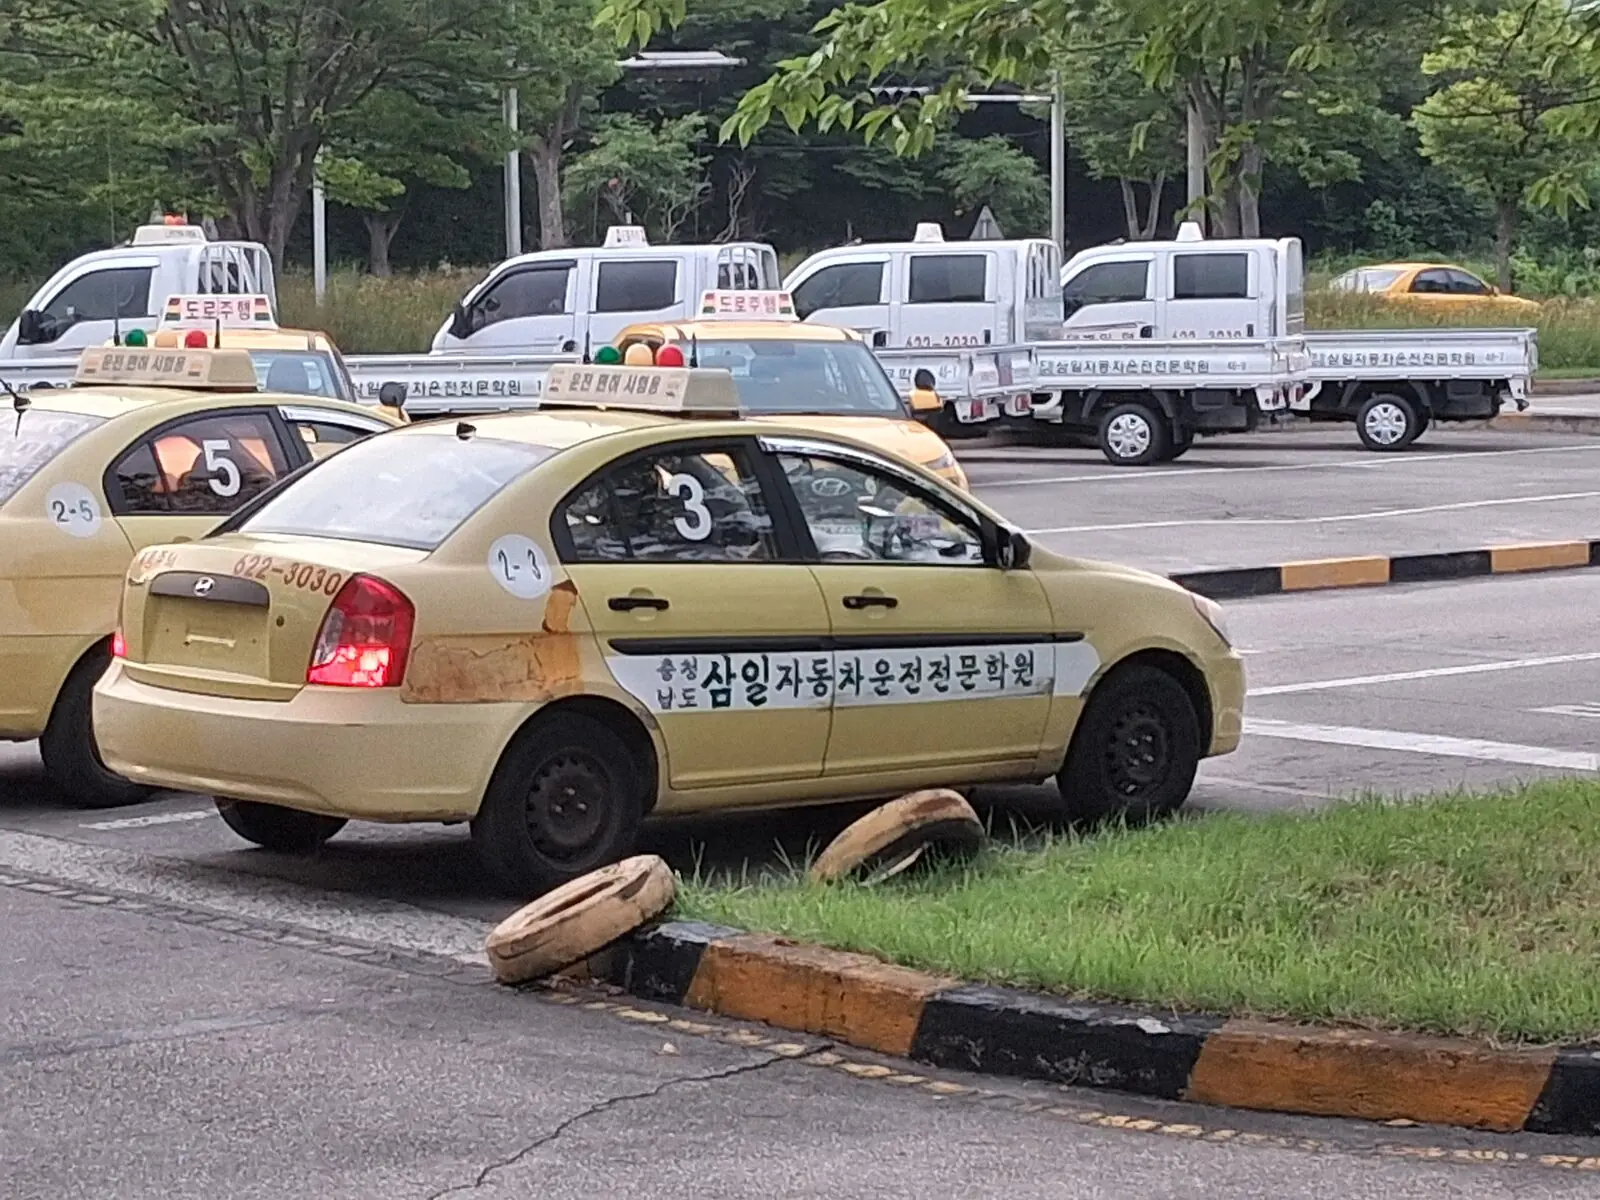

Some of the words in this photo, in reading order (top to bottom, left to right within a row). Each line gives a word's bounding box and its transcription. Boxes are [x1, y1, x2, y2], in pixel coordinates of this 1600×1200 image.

[185, 301, 250, 320] 도로주행
[719, 296, 776, 314] 도로주행
[568, 372, 594, 392] 운전
[202, 439, 241, 497] 5
[52, 499, 93, 522] 2-5
[669, 473, 713, 541] 3
[233, 552, 344, 597] 622-3030
[498, 549, 542, 582] 2-3
[656, 656, 698, 682] 충청
[701, 649, 1034, 709] 삼일자동차운전전문학원
[657, 686, 698, 710] 남도
